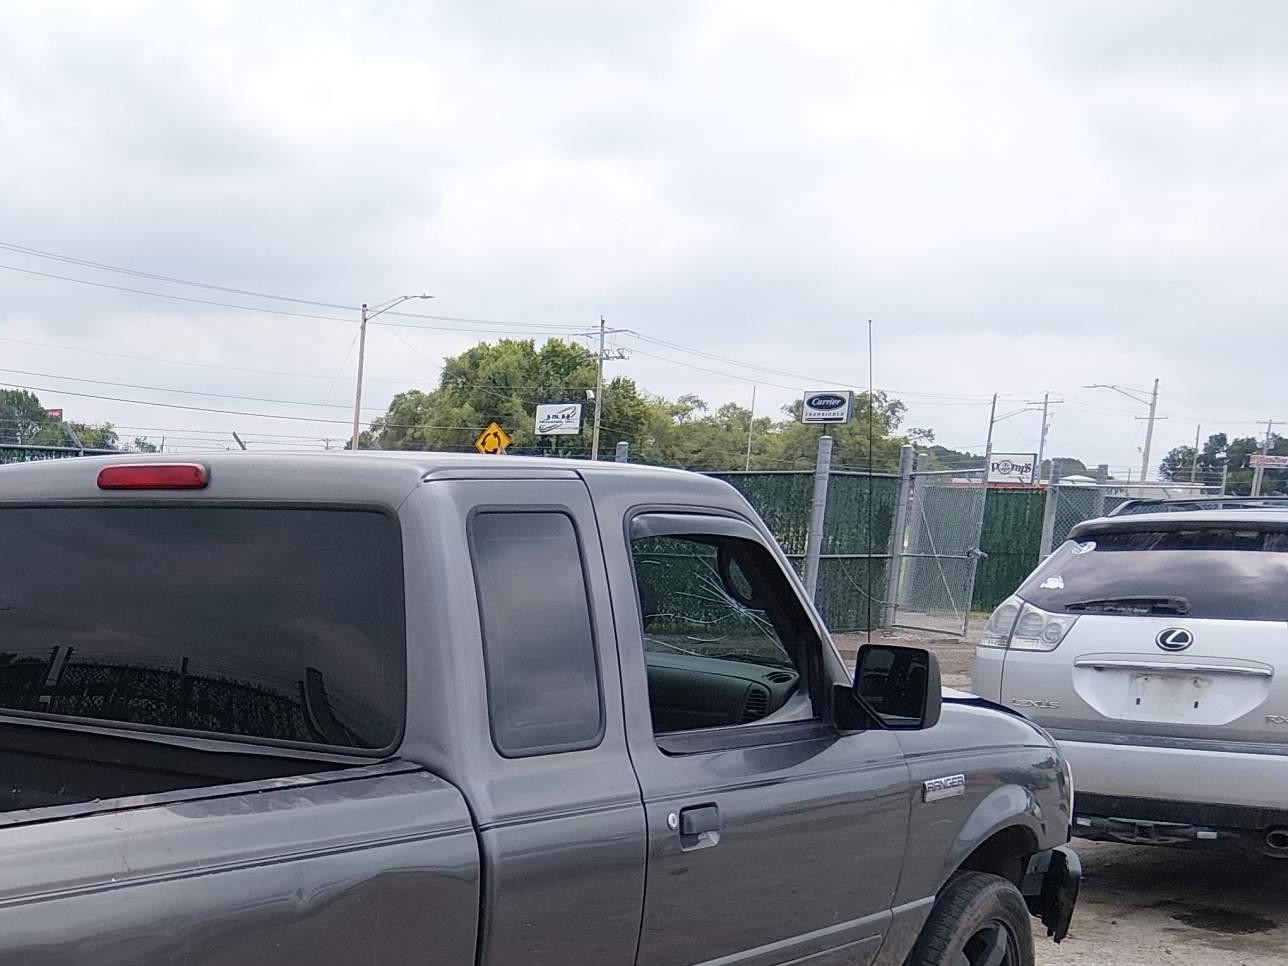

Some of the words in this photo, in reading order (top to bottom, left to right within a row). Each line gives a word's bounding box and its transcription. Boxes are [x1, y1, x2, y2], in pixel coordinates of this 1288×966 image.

[811, 397, 842, 406] Carrier
[1011, 698, 1061, 709] LEXUS
[925, 775, 965, 792] RANGER
